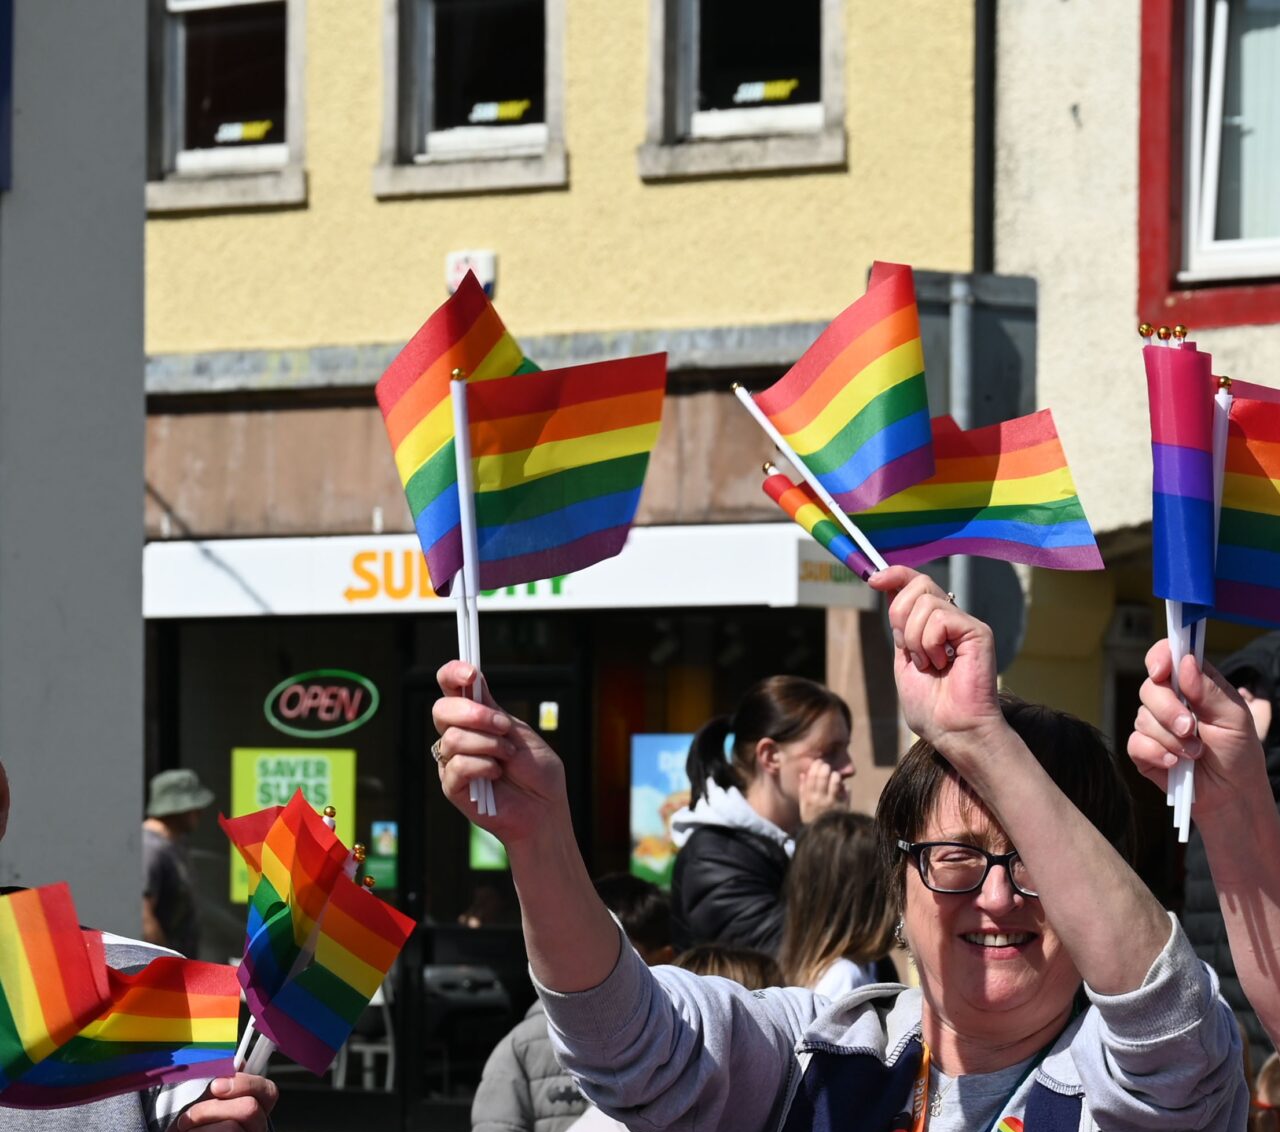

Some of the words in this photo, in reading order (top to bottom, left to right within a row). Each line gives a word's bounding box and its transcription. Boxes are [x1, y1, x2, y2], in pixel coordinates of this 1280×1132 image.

[279, 684, 363, 722] OPEN
[258, 759, 328, 779] SAVER
[914, 1078, 925, 1121] PRIDE
